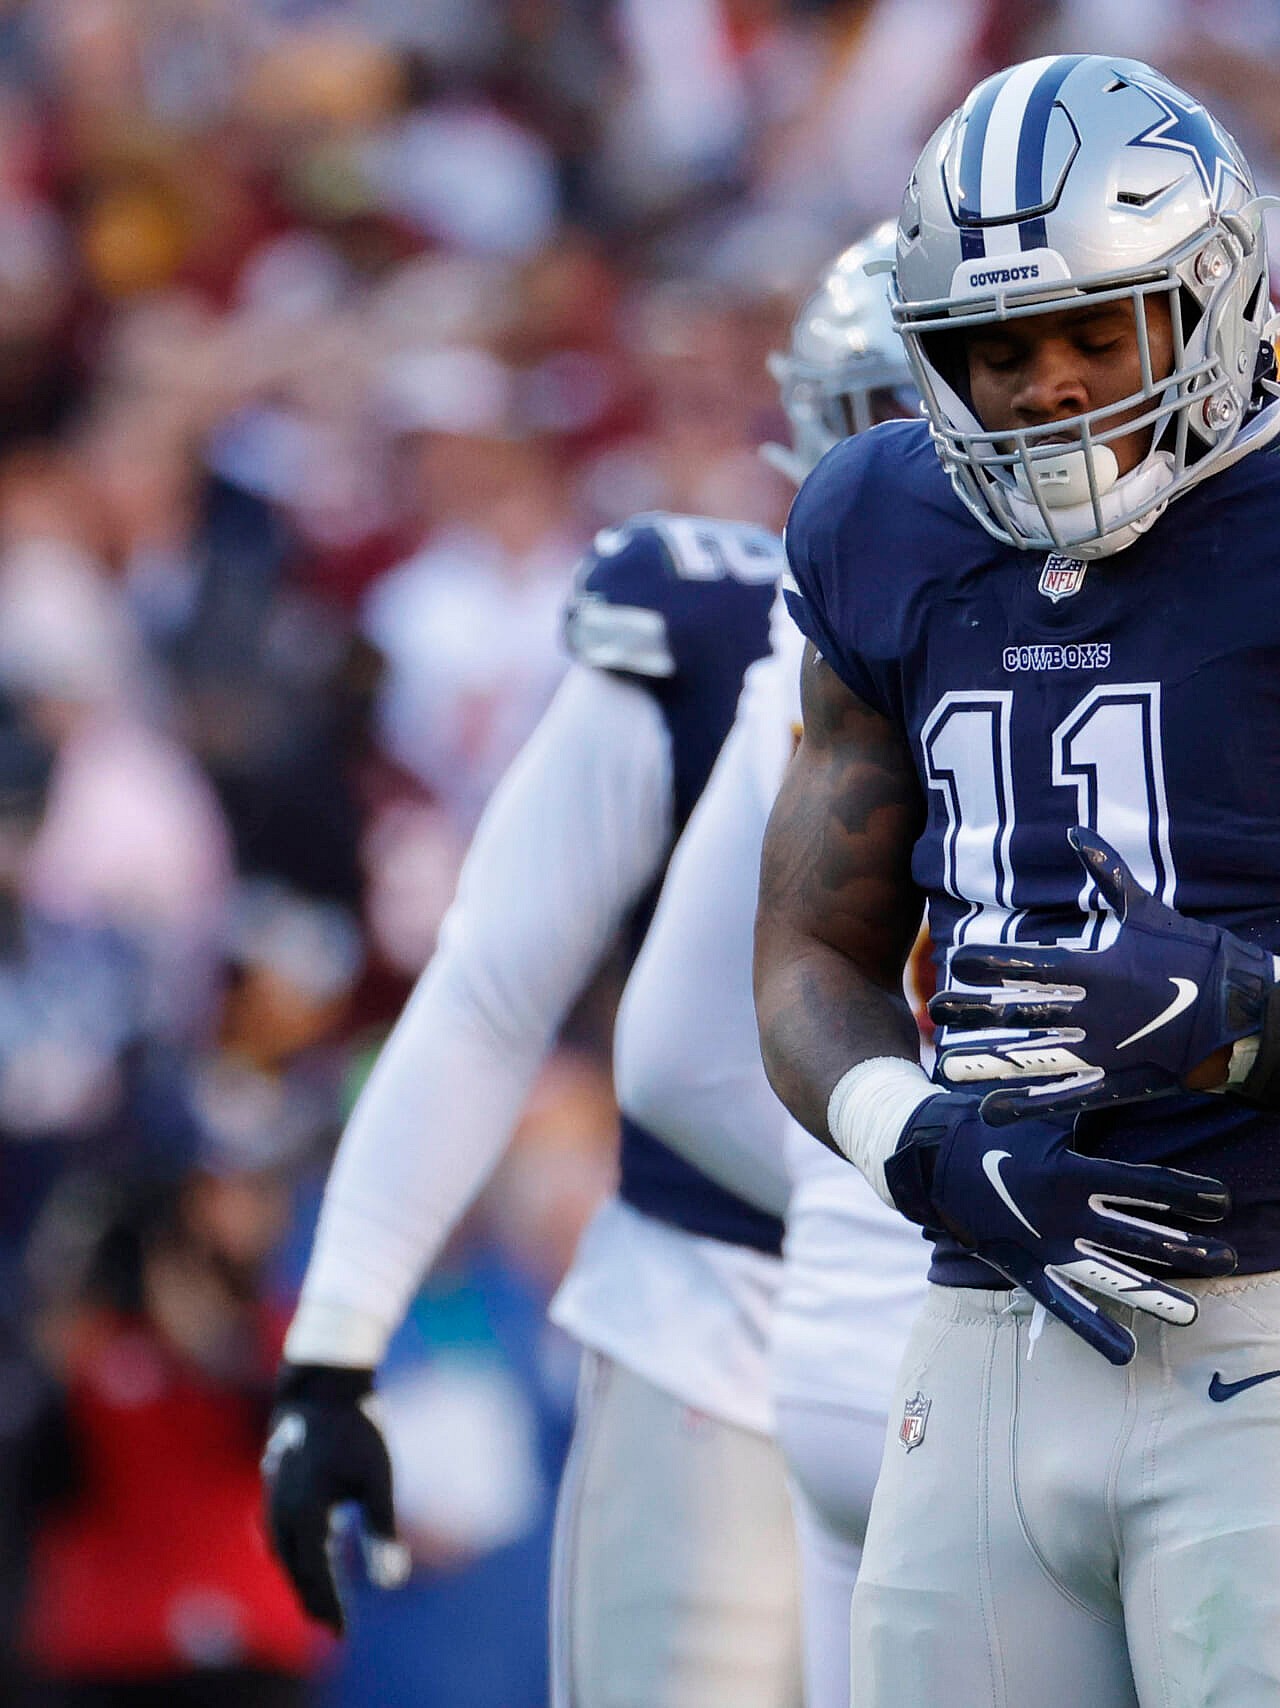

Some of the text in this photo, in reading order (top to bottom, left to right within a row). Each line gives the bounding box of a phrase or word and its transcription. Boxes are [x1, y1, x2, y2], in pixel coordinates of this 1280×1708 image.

[969, 264, 1040, 288] COWBOYS
[1045, 571, 1075, 592] NFL
[1002, 643, 1111, 672] COWBOYS
